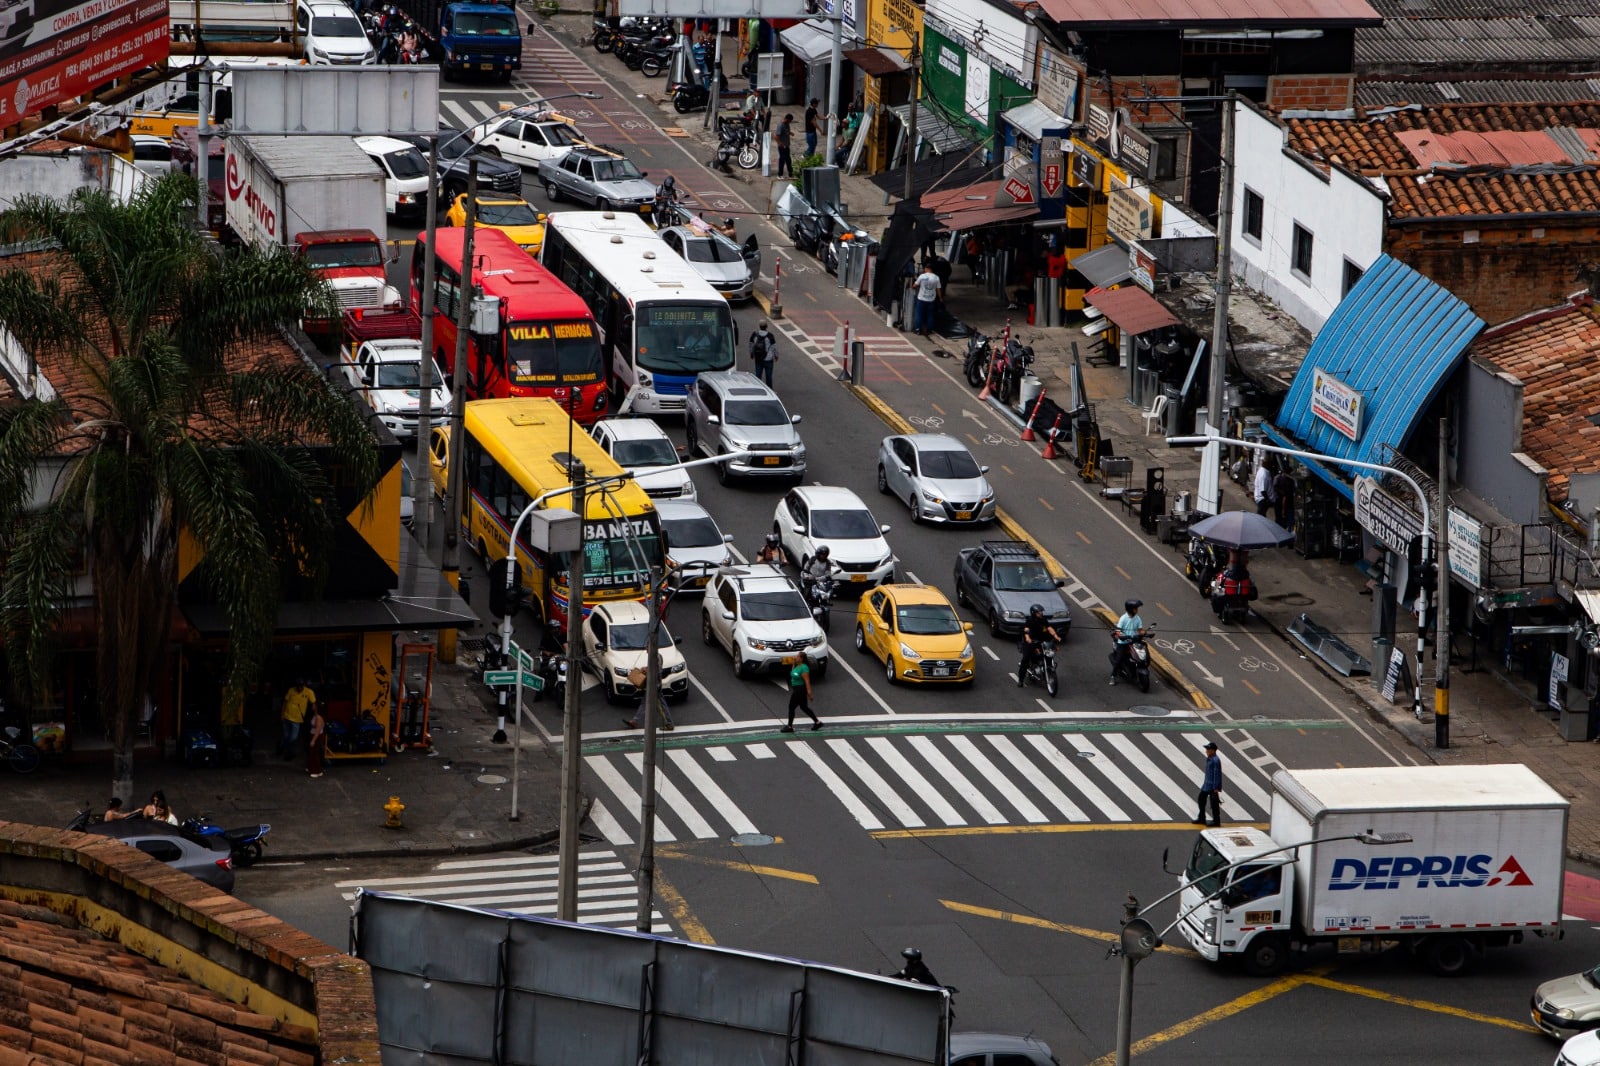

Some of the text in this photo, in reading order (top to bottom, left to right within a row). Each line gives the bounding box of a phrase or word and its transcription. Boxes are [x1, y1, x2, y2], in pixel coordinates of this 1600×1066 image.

[53, 11, 82, 31] COMPRA,
[83, 3, 102, 20] VENTA
[122, 41, 133, 54] CEL:
[510, 324, 593, 340] VILLA HERMOSA
[638, 392, 650, 400] 063
[1370, 502, 1391, 527] SERVICIO
[1391, 518, 1398, 532] DE
[483, 516, 510, 552] SOTRAM
[583, 520, 654, 540] BANETA
[1374, 520, 1385, 540] 313
[1385, 528, 1397, 549] 570
[1397, 537, 1405, 555] 73
[1457, 524, 1480, 543] METALICOS
[1457, 532, 1479, 549] SAN JUAN
